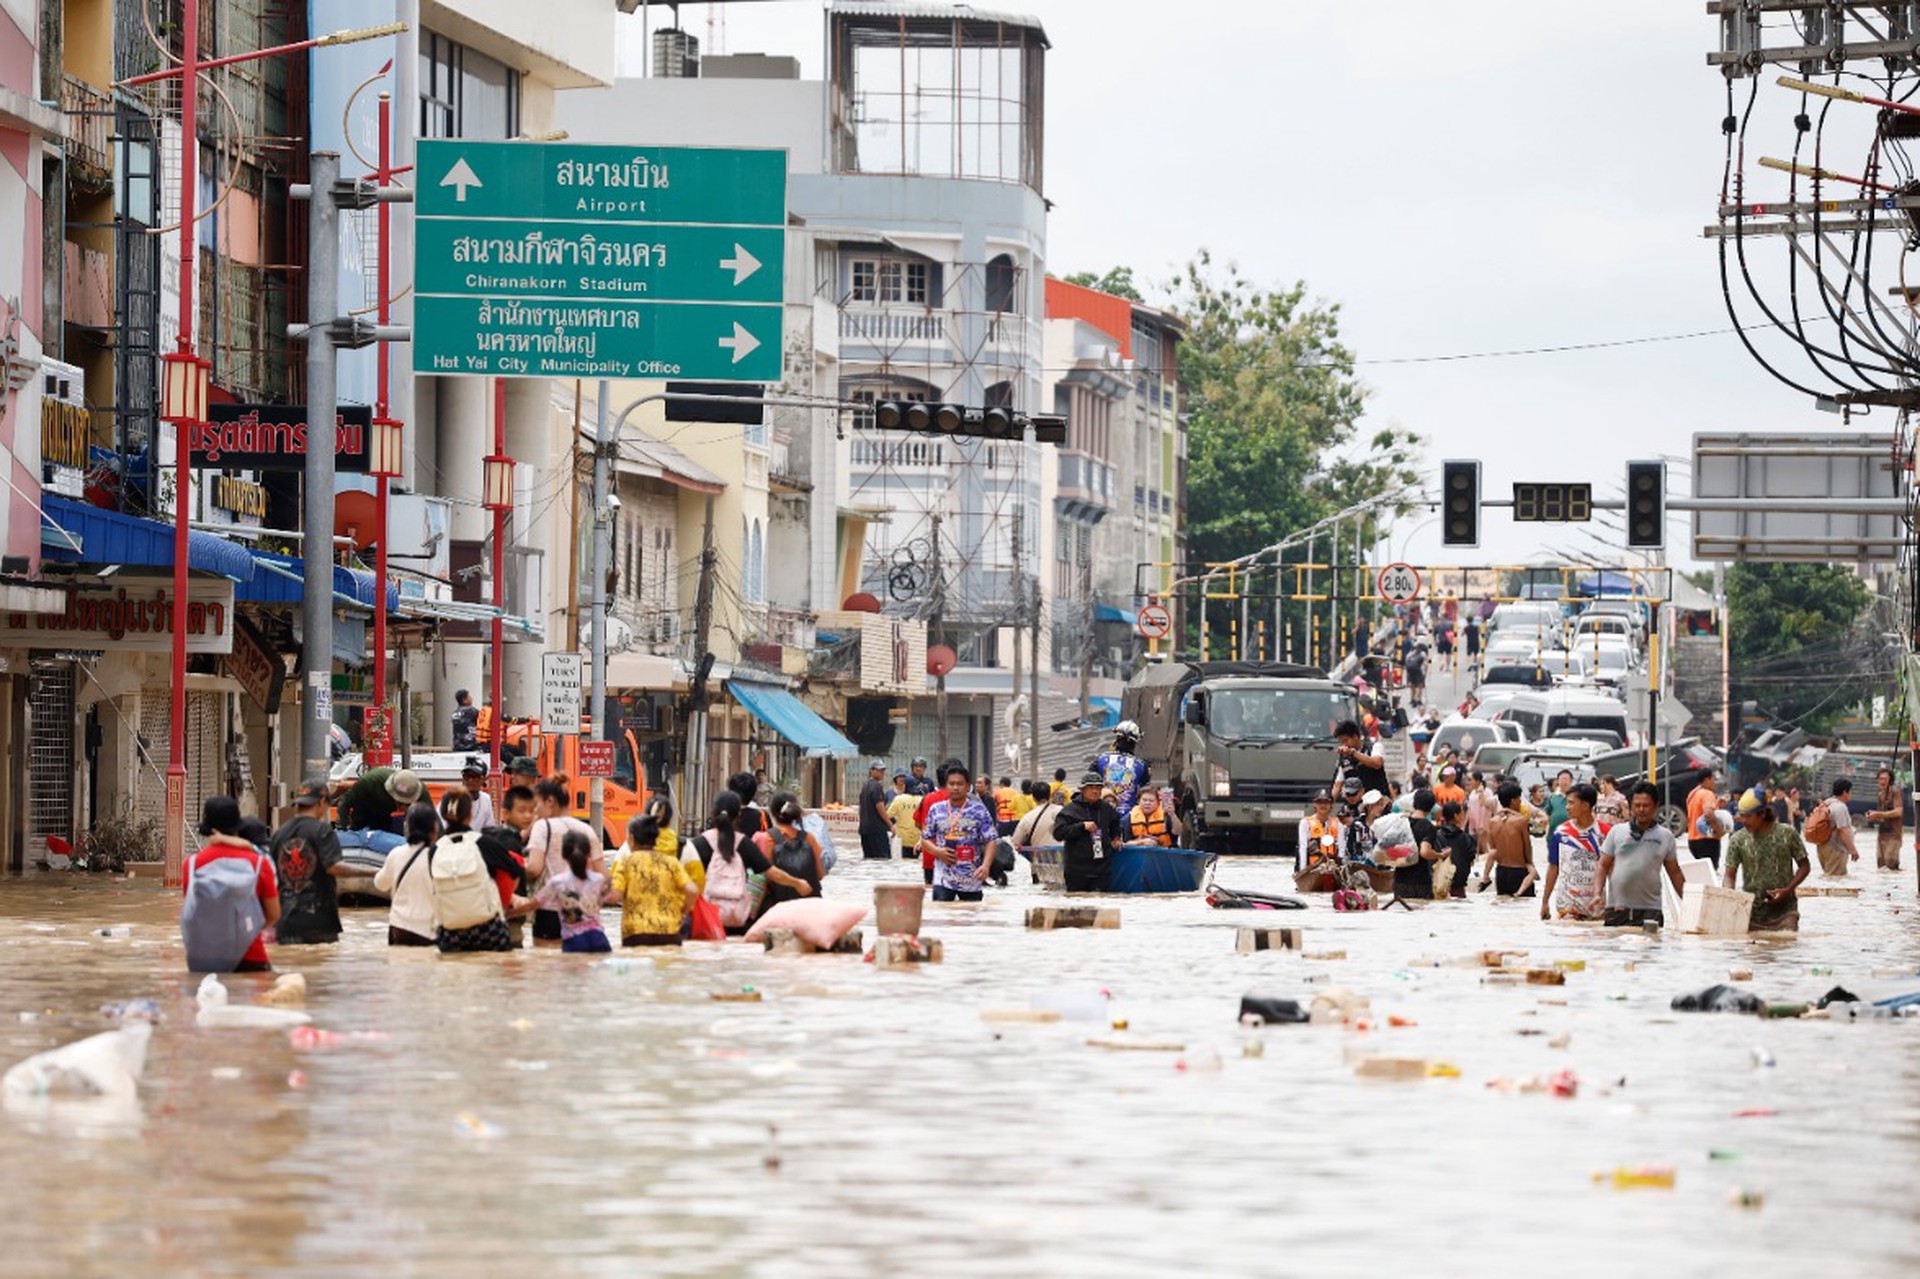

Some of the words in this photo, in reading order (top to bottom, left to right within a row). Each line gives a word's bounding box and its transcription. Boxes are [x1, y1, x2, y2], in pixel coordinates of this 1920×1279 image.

[558, 156, 669, 189] สนามบิน
[576, 198, 646, 213] Airport
[453, 231, 666, 268] สนามกีฬาจิรนคร
[466, 274, 567, 289] Chiranakorn
[580, 278, 647, 292] Stadium
[478, 299, 640, 329] สำนักงานเทศบาล
[476, 327, 596, 358] นครหาดใหญ่
[433, 355, 459, 368] Hat
[466, 356, 488, 369] Yai
[498, 357, 528, 373] City
[541, 358, 630, 376] Municipality
[637, 360, 681, 374] Office
[1384, 576, 1407, 590] 2.80
[557, 656, 571, 664] NO
[551, 667, 576, 676] TURN
